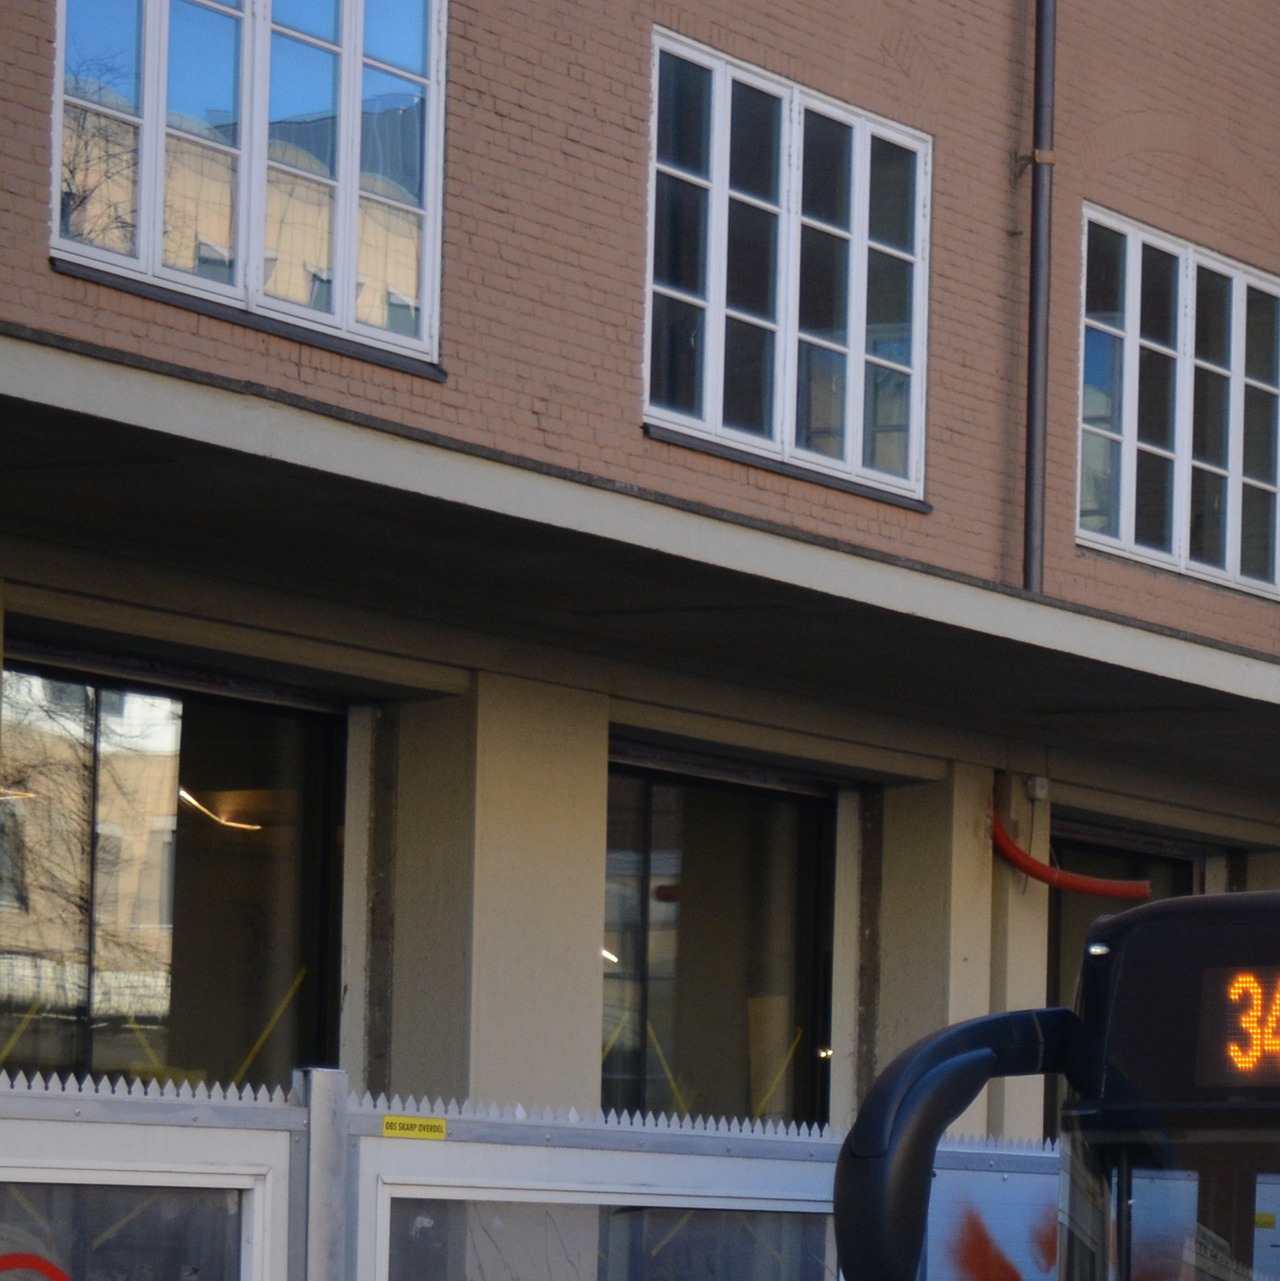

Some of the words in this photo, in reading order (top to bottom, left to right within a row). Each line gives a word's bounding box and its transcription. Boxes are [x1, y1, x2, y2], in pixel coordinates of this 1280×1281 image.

[385, 1121, 397, 1131] OBS
[398, 1122, 417, 1132] SKARP
[418, 1123, 443, 1134] OVERDEL
